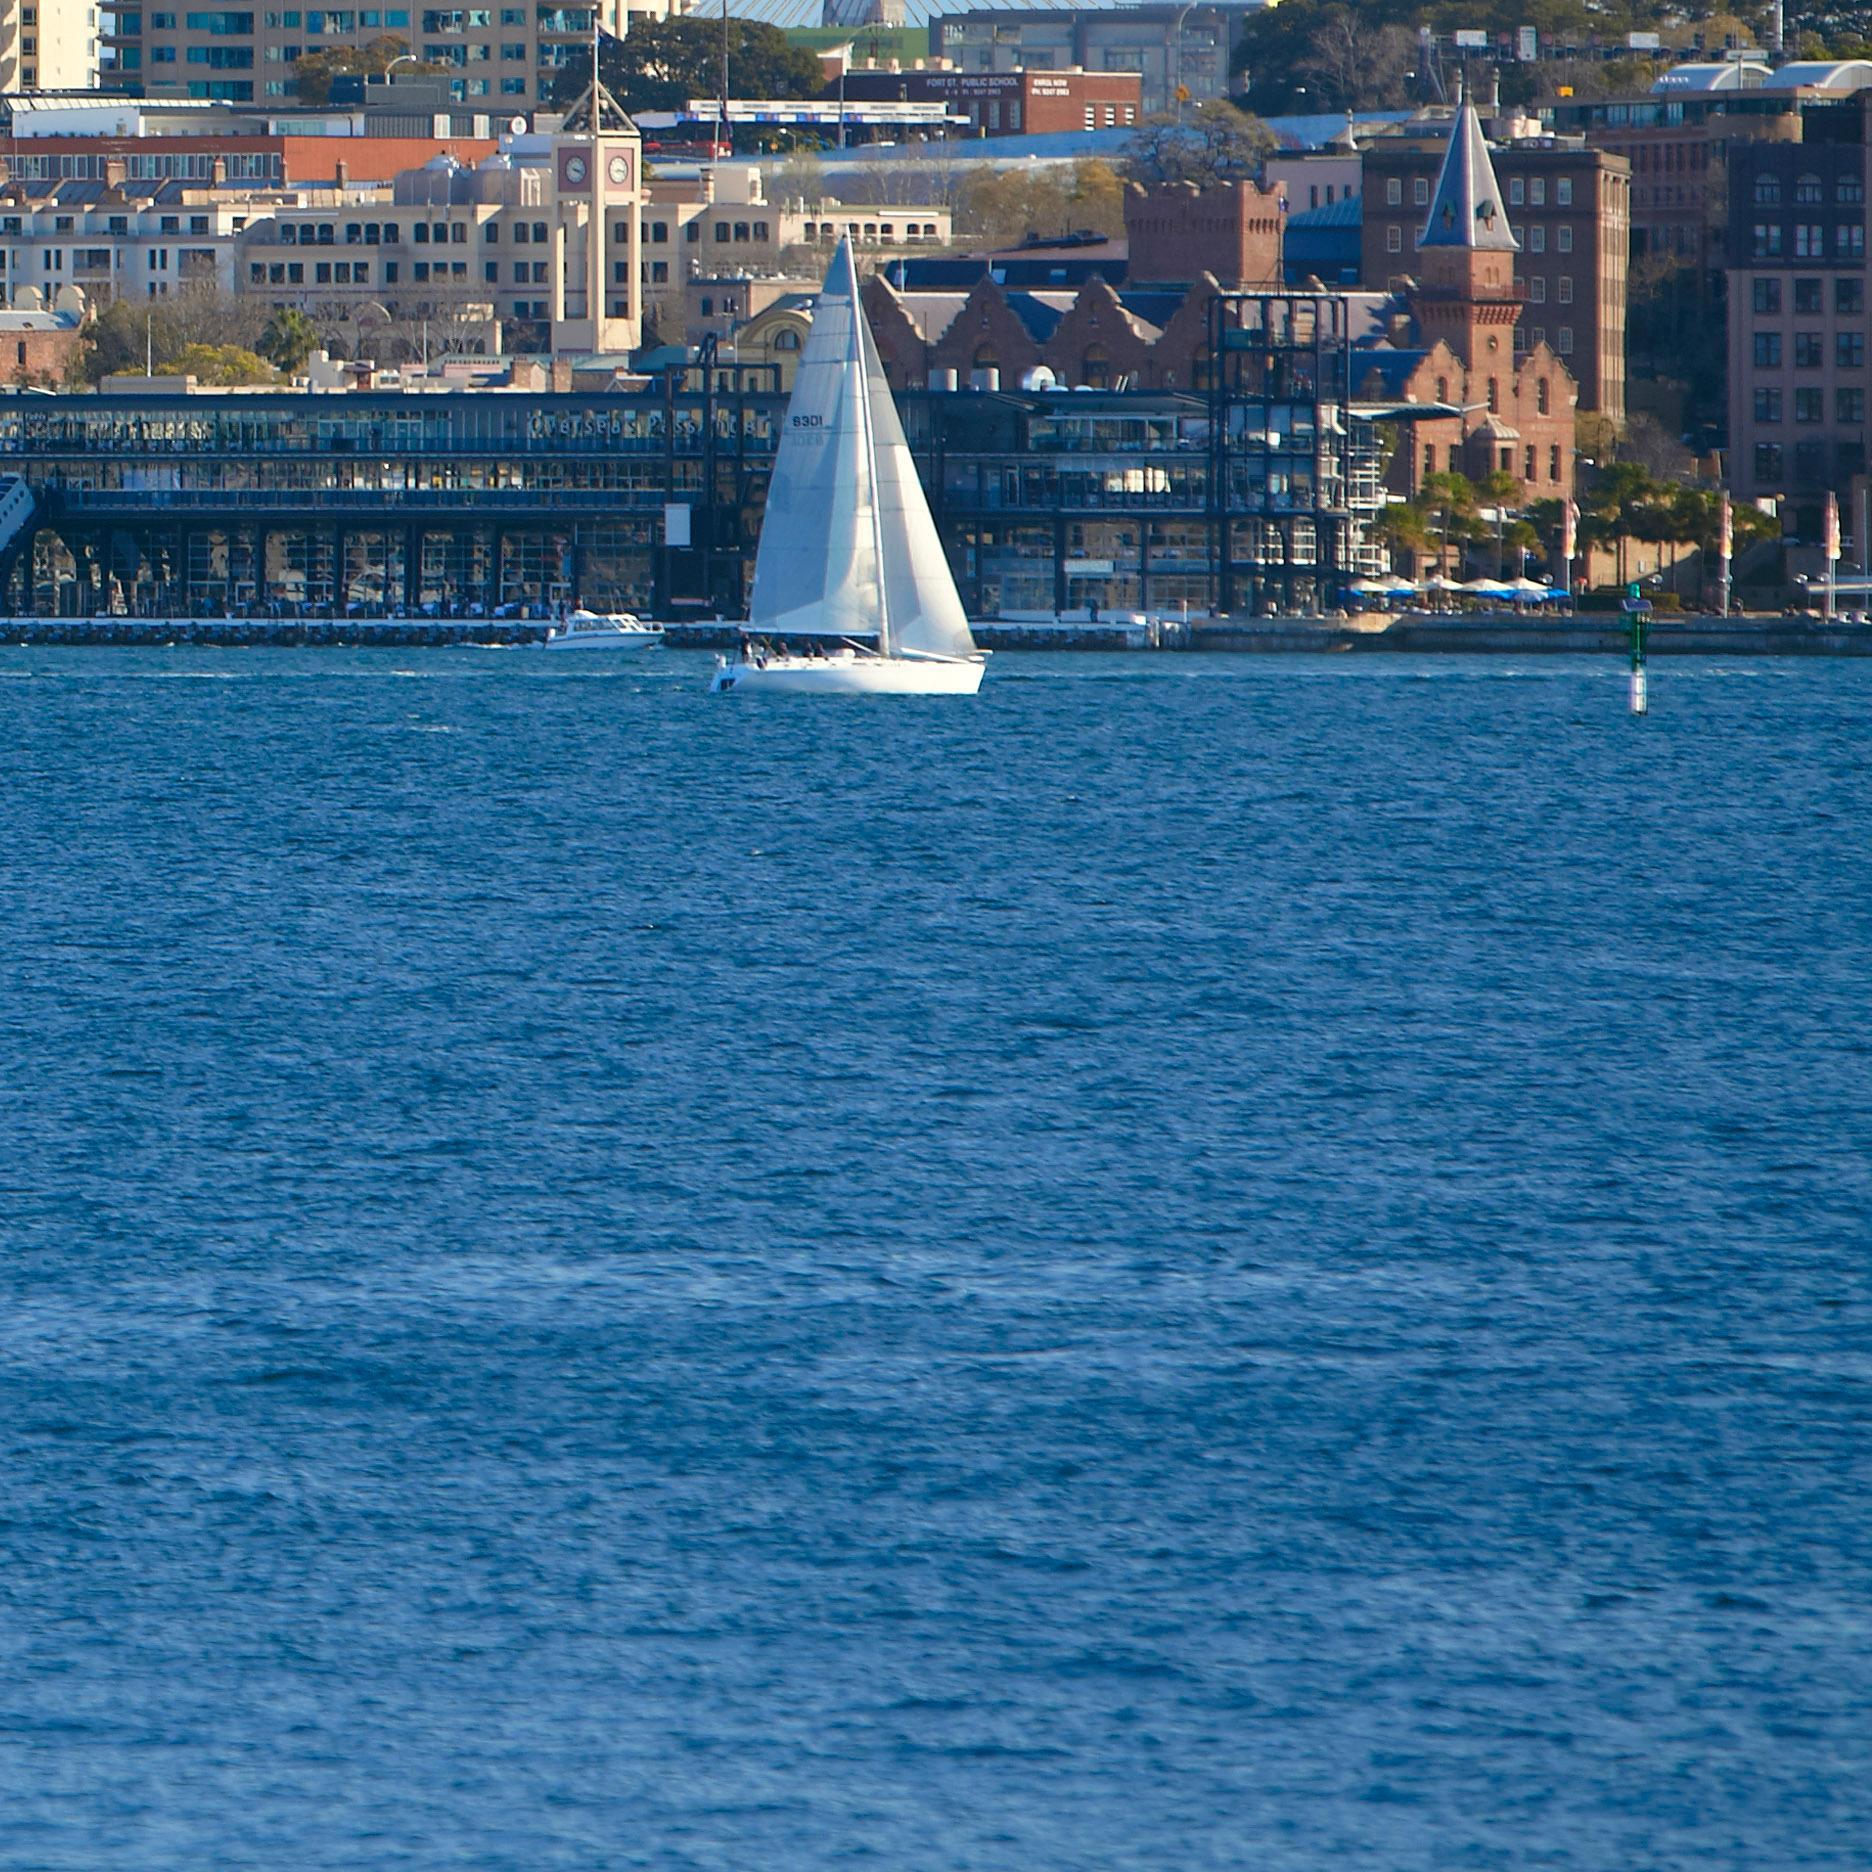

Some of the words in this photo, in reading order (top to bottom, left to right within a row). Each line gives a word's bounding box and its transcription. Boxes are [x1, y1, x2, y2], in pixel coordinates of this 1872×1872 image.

[926, 78, 945, 87] FORT
[961, 77, 988, 86] PUBLIC
[989, 77, 1018, 86] SCHOOL
[528, 414, 641, 436] Overseas
